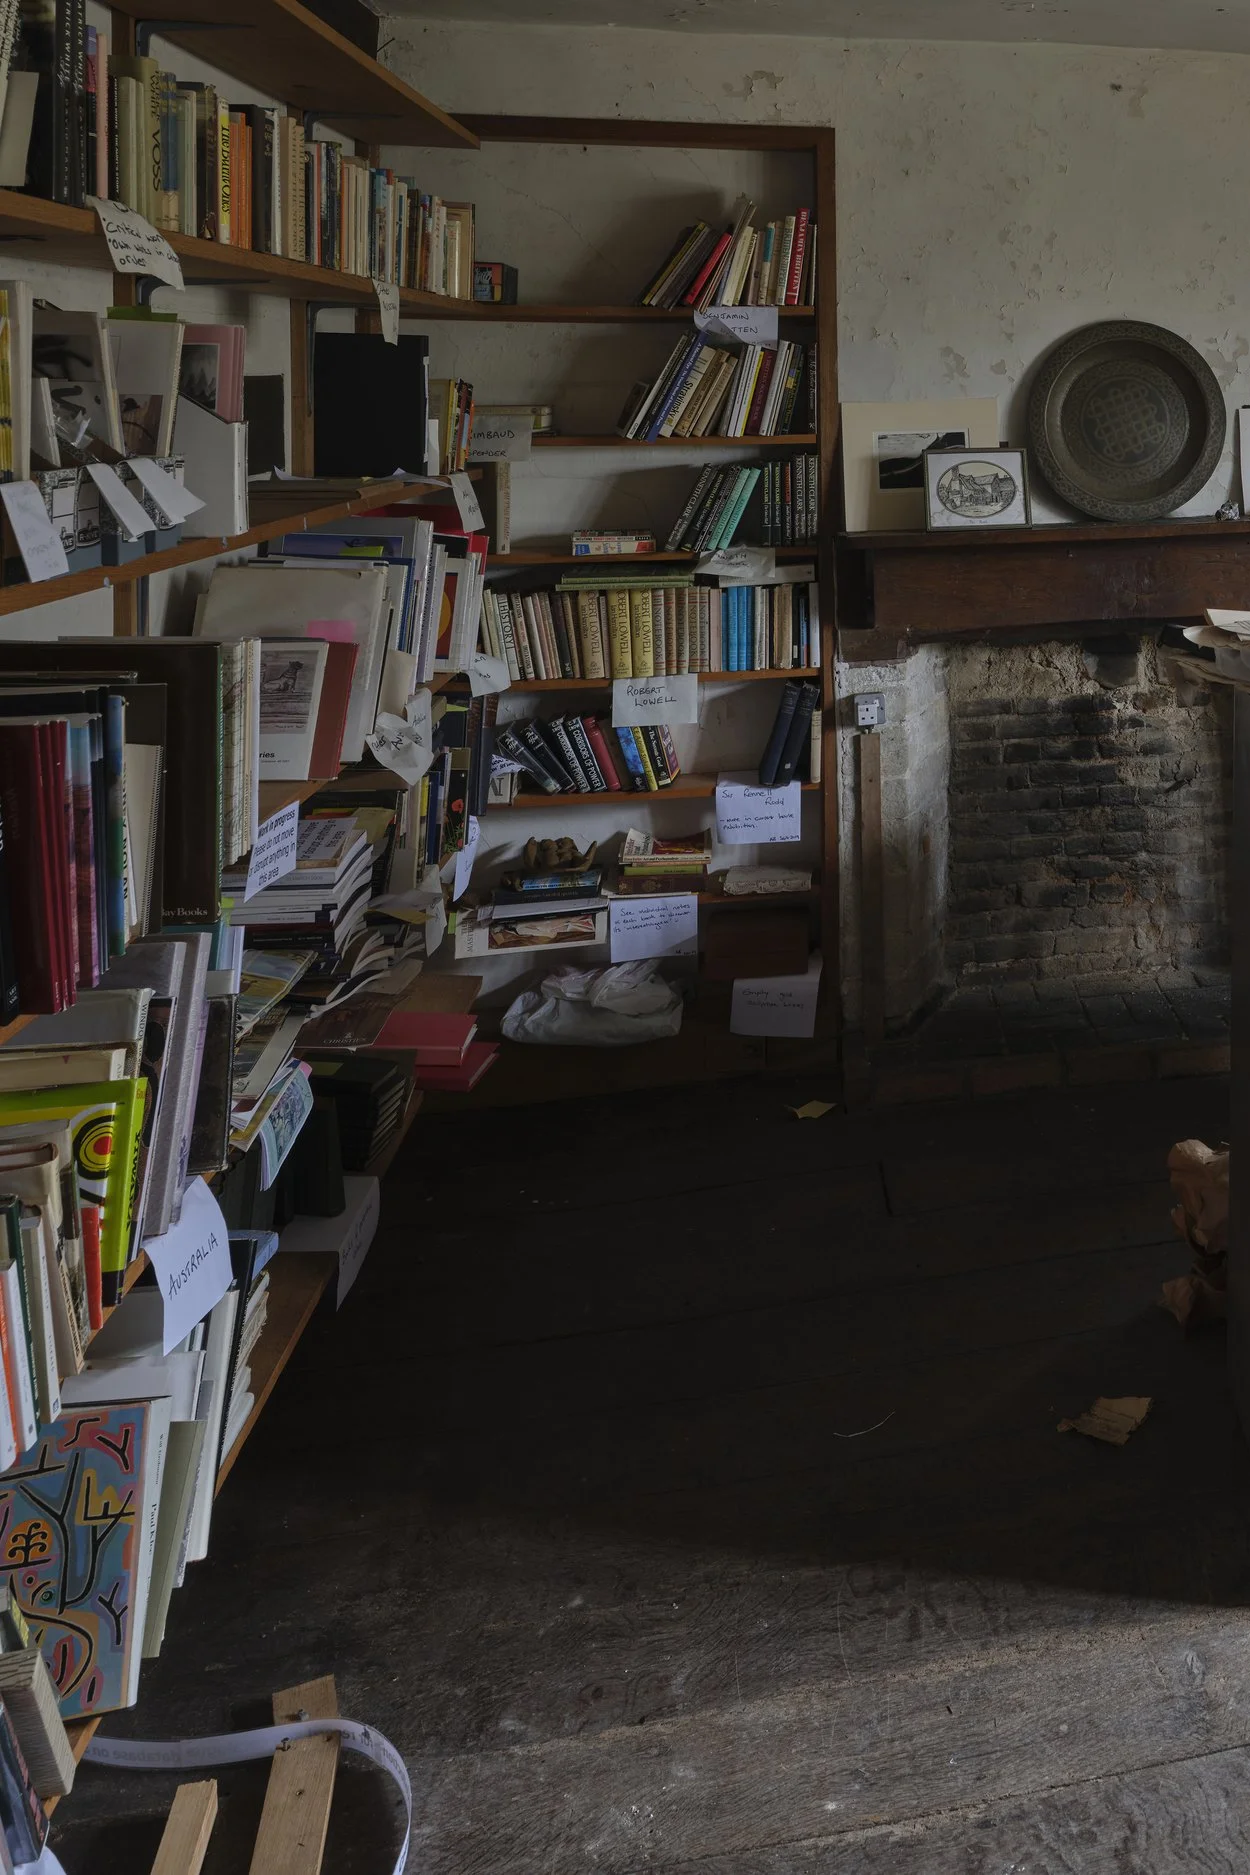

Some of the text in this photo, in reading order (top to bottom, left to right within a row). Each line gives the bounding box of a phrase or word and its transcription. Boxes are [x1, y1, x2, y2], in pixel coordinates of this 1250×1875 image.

[64, 0, 72, 36] TRICK
[152, 128, 161, 192] VOSS
[792, 211, 808, 290] BENJAMIN BRITTEN
[731, 326, 759, 334] TTEN
[668, 380, 694, 419] Stravinsky
[473, 430, 515, 440] IMBAUD
[681, 465, 712, 519] KENNETH CLARK
[794, 457, 803, 511] KENNETH CLARK
[807, 457, 816, 511] KENNETH CLARK
[730, 498, 745, 524] KENNETH
[499, 604, 514, 645] HISTORY
[586, 620, 602, 657] LOWELL
[610, 613, 618, 639] Hamilton
[617, 620, 630, 656] LOWELL
[633, 612, 641, 638] Hamilton
[641, 620, 651, 656] LOWELL
[656, 607, 664, 660] NOTEBOOK
[667, 606, 676, 659] NOTEBOOK
[678, 606, 686, 658] NOTEBOOK
[690, 605, 698, 658] NOTEBOOK
[700, 604, 708, 658] NOTEBOOK
[521, 644, 532, 669] IMITATIONS
[626, 686, 666, 697] ROBERT
[634, 696, 677, 707] LOWELL
[259, 751, 276, 759] ries
[555, 729, 587, 790] CORRIDORS OF POWER
[570, 728, 602, 788] CORRIDORS OF POWER
[254, 827, 295, 857] Please do not move
[257, 825, 269, 839] Work
[273, 809, 296, 830] progress
[253, 857, 269, 874] disrupt
[268, 845, 290, 864] anything
[258, 866, 280, 887] this area
[176, 907, 209, 917] Books
[620, 908, 635, 917] See
[742, 988, 769, 998] Empty
[168, 1232, 219, 1301] AUSTRALIA
[149, 1502, 157, 1527] Paul
